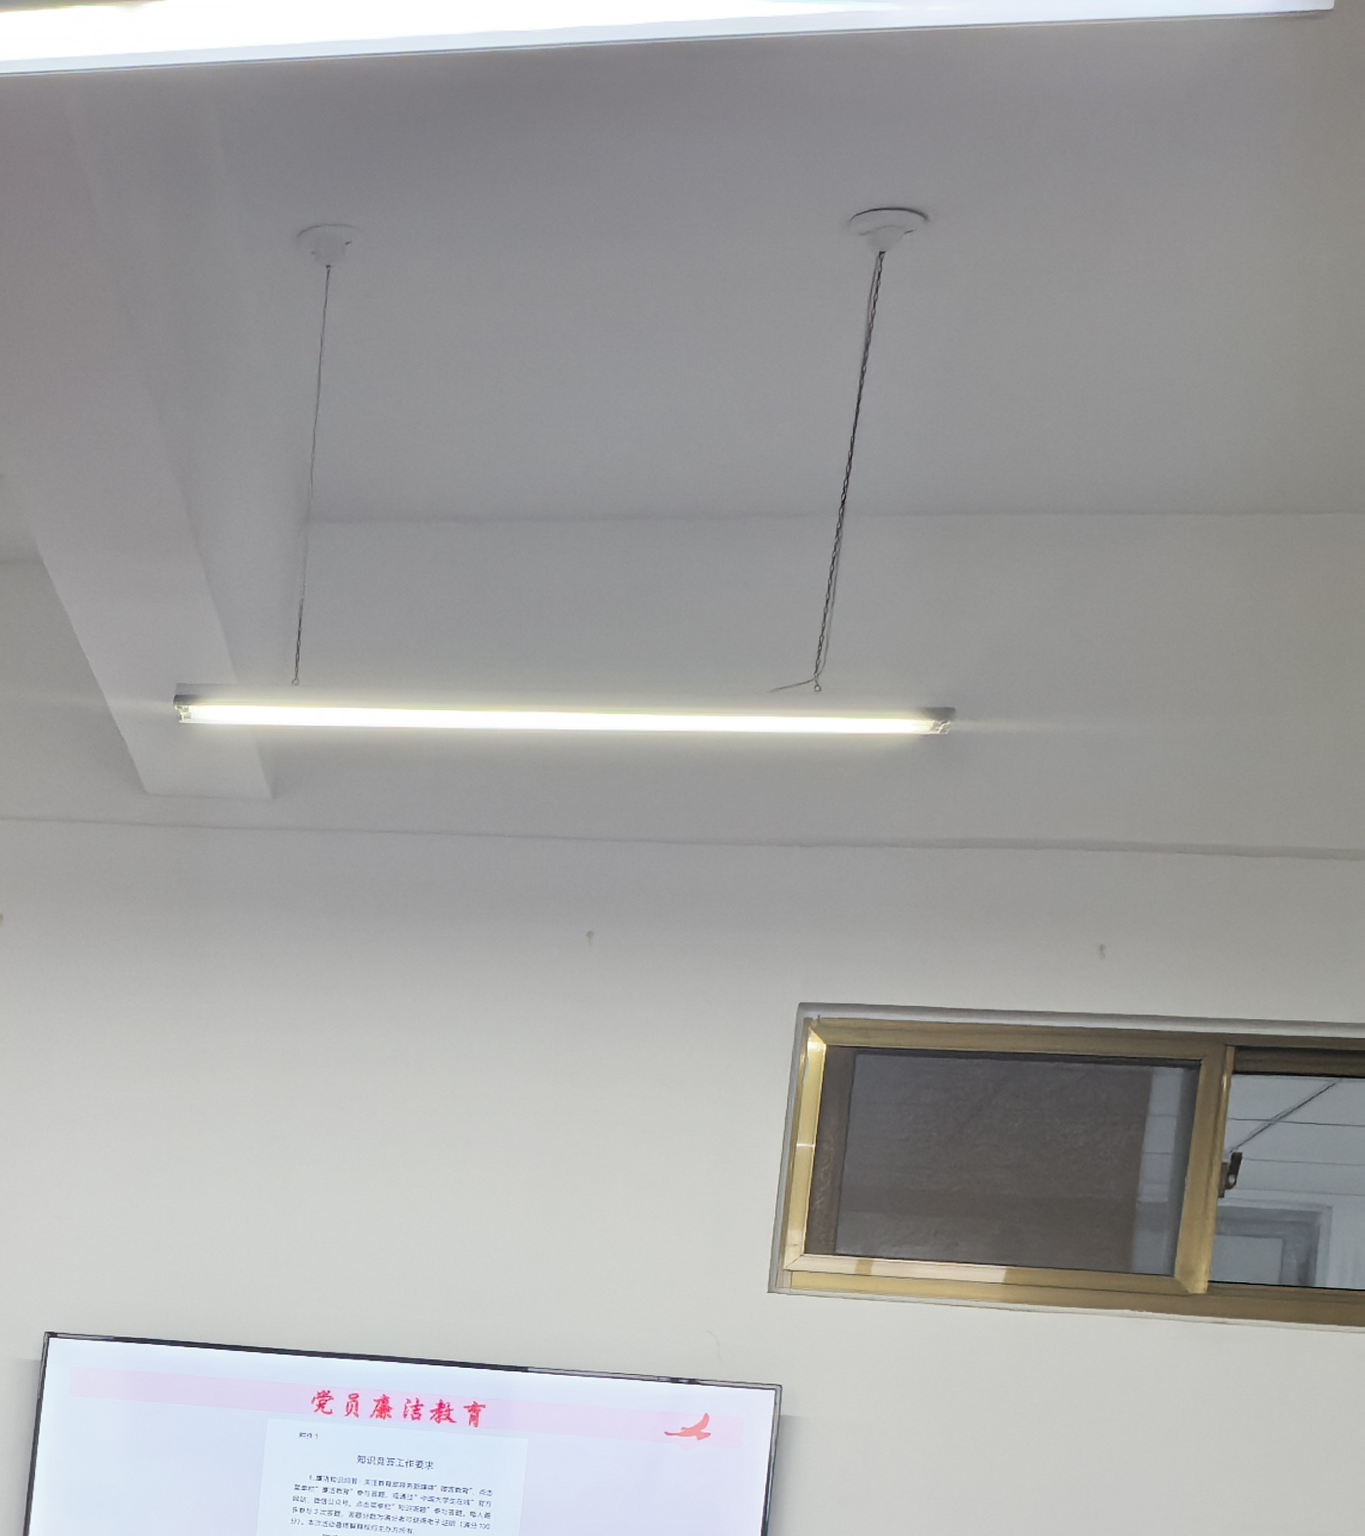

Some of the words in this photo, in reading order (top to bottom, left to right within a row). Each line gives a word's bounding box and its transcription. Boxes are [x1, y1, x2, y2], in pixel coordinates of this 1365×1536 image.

[309, 1390, 488, 1429] 党员廉洁教育
